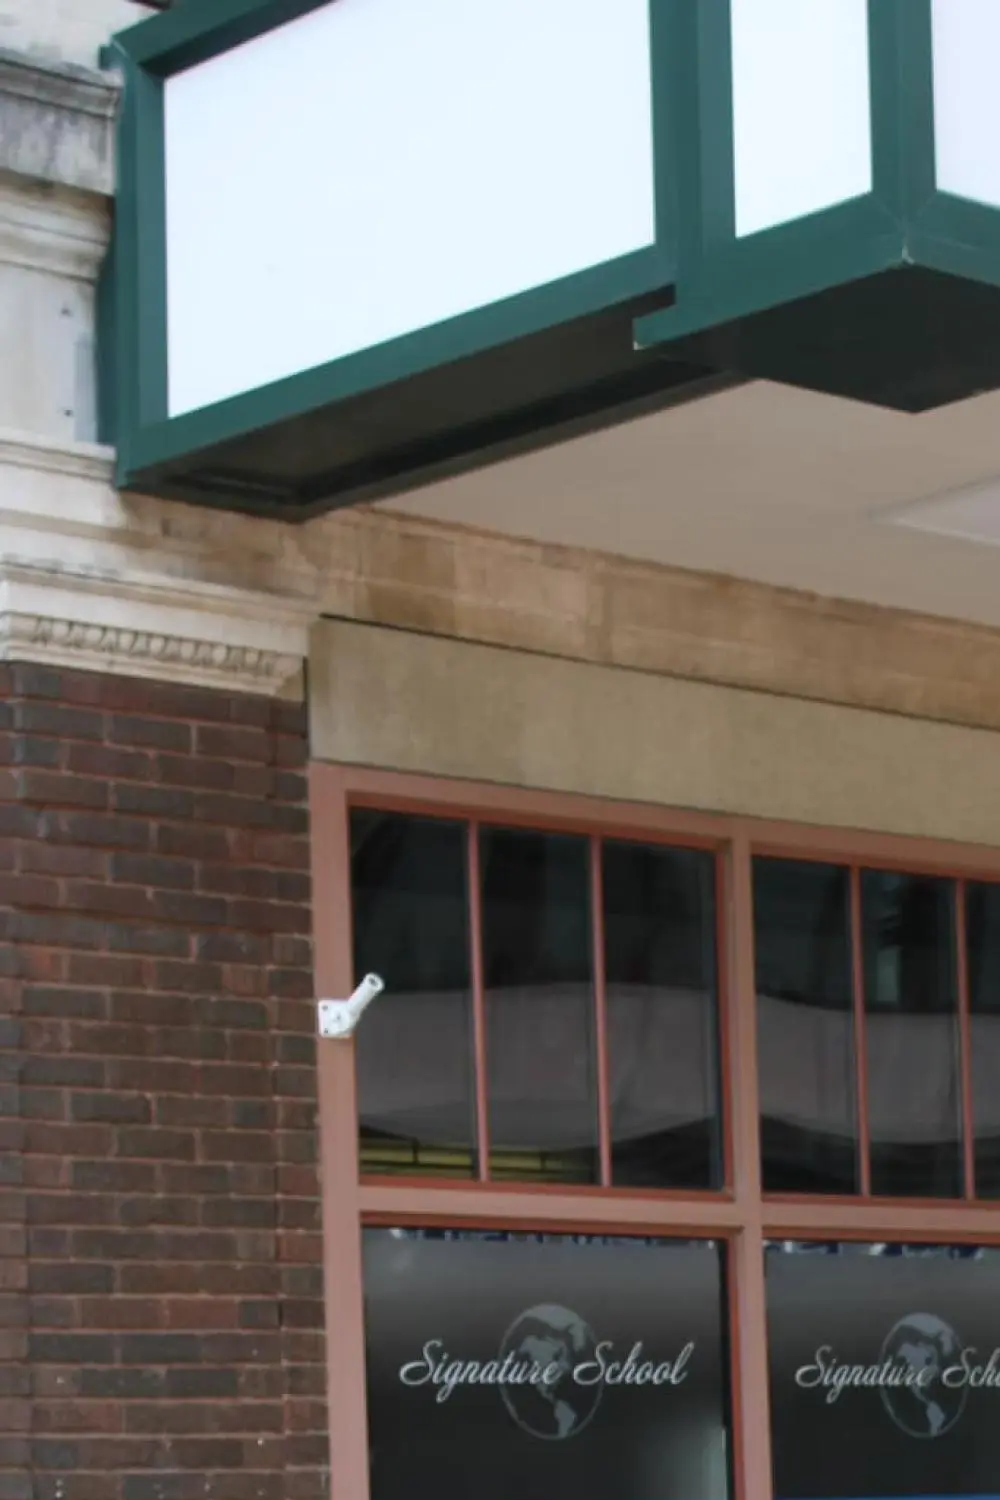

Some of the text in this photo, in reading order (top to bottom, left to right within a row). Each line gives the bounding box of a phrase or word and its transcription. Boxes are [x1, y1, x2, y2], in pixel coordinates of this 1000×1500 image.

[400, 1339, 694, 1403] Signature School
[794, 1344, 932, 1404] Signature
